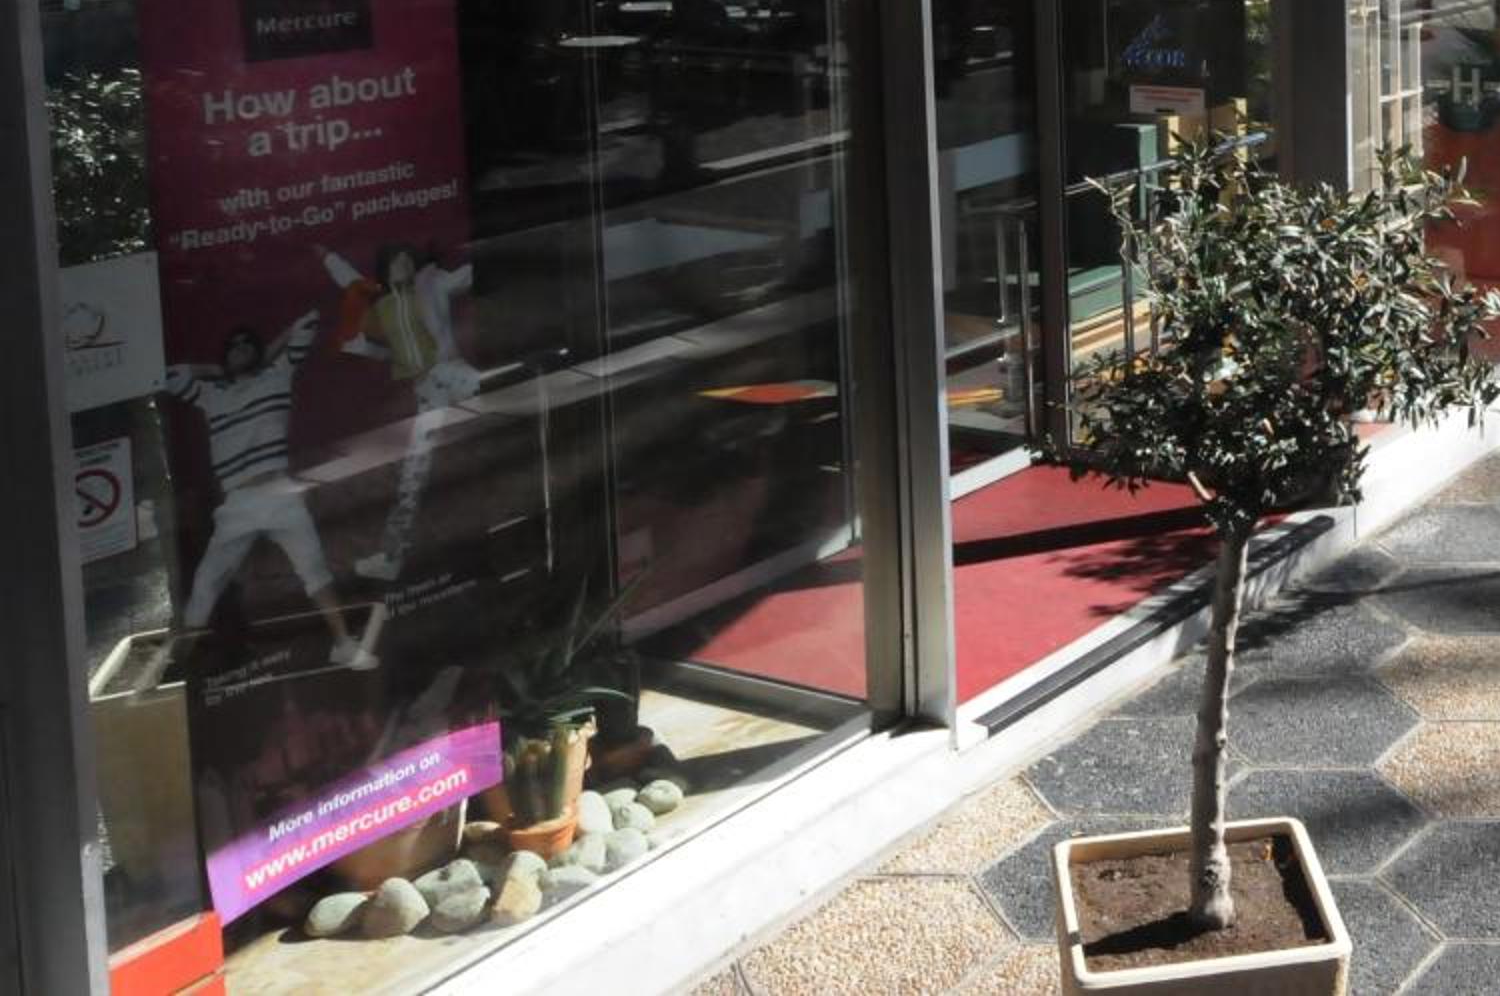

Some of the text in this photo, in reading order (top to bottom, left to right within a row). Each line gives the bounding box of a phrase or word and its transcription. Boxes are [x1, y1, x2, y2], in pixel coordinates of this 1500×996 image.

[255, 11, 358, 35] Mercure
[202, 66, 418, 124] How about
[247, 115, 383, 158] a trip...
[219, 160, 417, 214] with our fantastic
[351, 178, 459, 221] packages!
[268, 752, 441, 842] More information on
[244, 768, 469, 890] www.mercure.com
